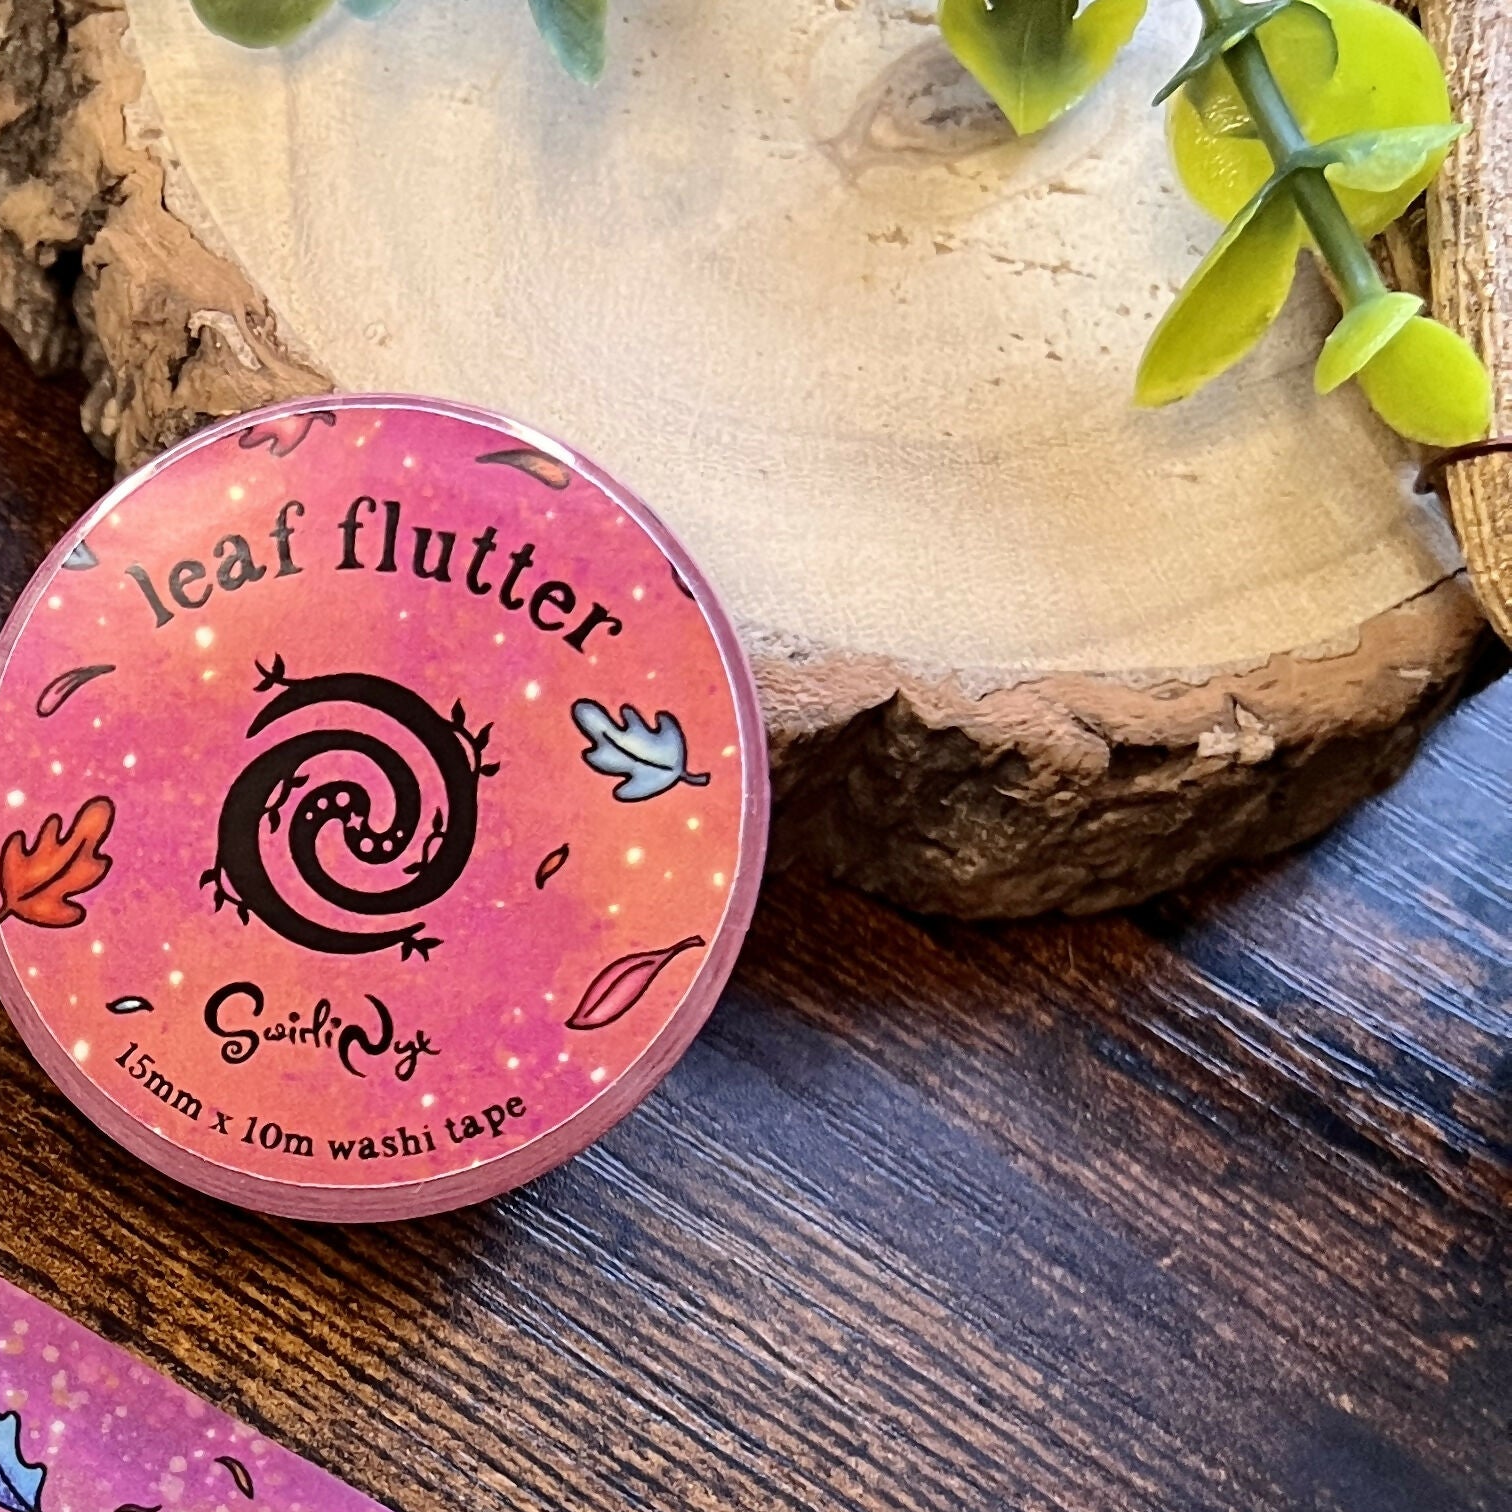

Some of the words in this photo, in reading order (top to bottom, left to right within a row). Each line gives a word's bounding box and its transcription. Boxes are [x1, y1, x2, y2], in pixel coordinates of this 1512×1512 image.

[125, 500, 305, 628] leaf
[336, 496, 623, 653] flutter
[115, 1041, 203, 1120] 15mm
[208, 1110, 234, 1135] x
[241, 1116, 314, 1157] 10m
[328, 1124, 436, 1160] washi
[444, 1095, 527, 1143] tape
